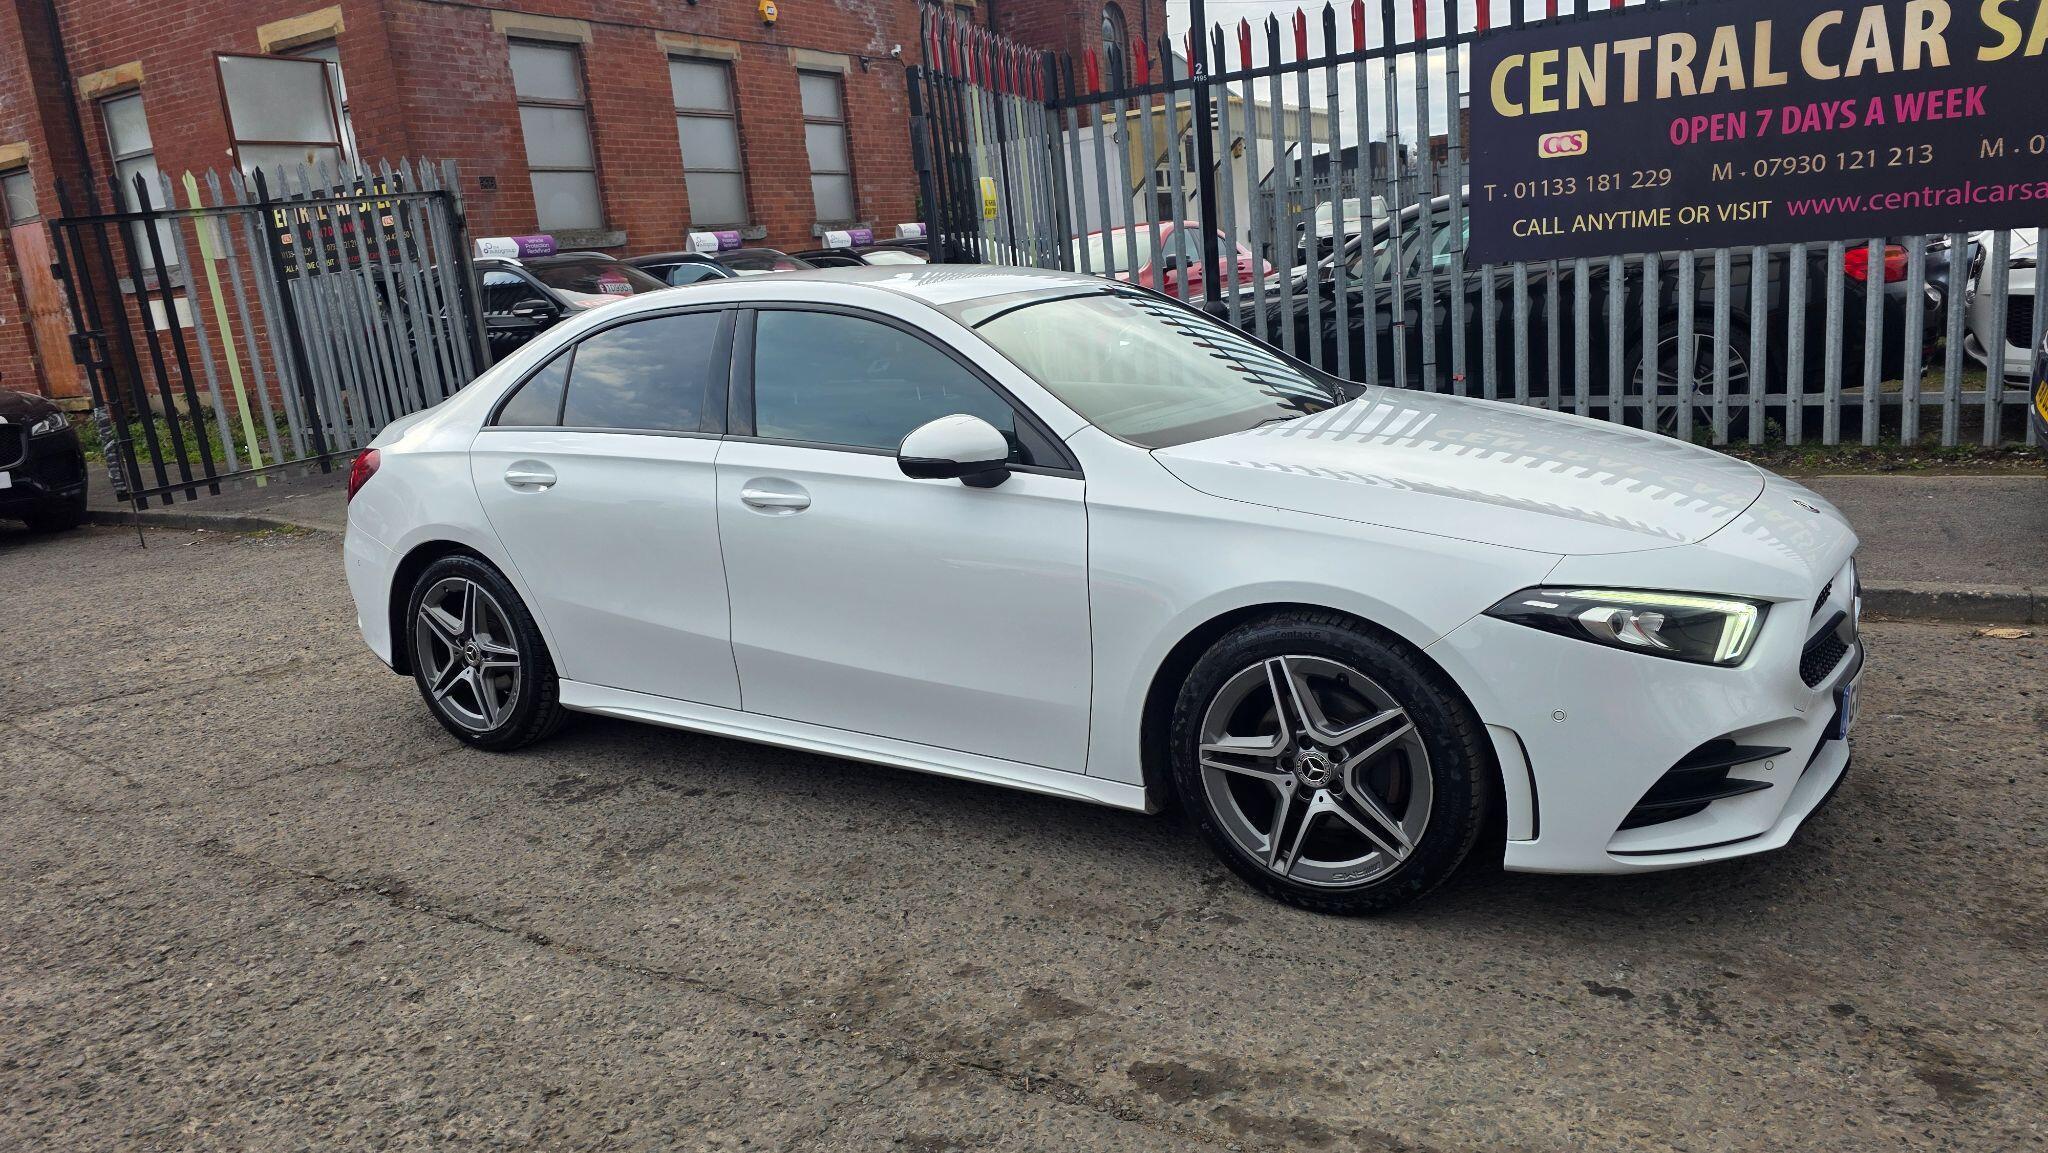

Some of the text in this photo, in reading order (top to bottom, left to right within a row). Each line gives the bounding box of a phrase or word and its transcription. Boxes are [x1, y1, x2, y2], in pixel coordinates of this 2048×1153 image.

[1195, 63, 1203, 74] 2
[1490, 20, 1788, 117] CENTRAL
[1800, 0, 1952, 81] CAR
[1669, 85, 1987, 146] OPEN 7 DAYS A WEEK
[1753, 153, 1826, 178] 07930
[1836, 149, 1875, 170] 121
[1887, 144, 1934, 167] 213
[2029, 134, 2048, 155] 0
[1514, 177, 1577, 199] 01133
[1586, 173, 1621, 193] 181
[1631, 168, 1672, 189] 229
[1787, 181, 2048, 217] www.centralcarsa
[1512, 200, 1773, 237] CALL ANYTIME OR VISIT
